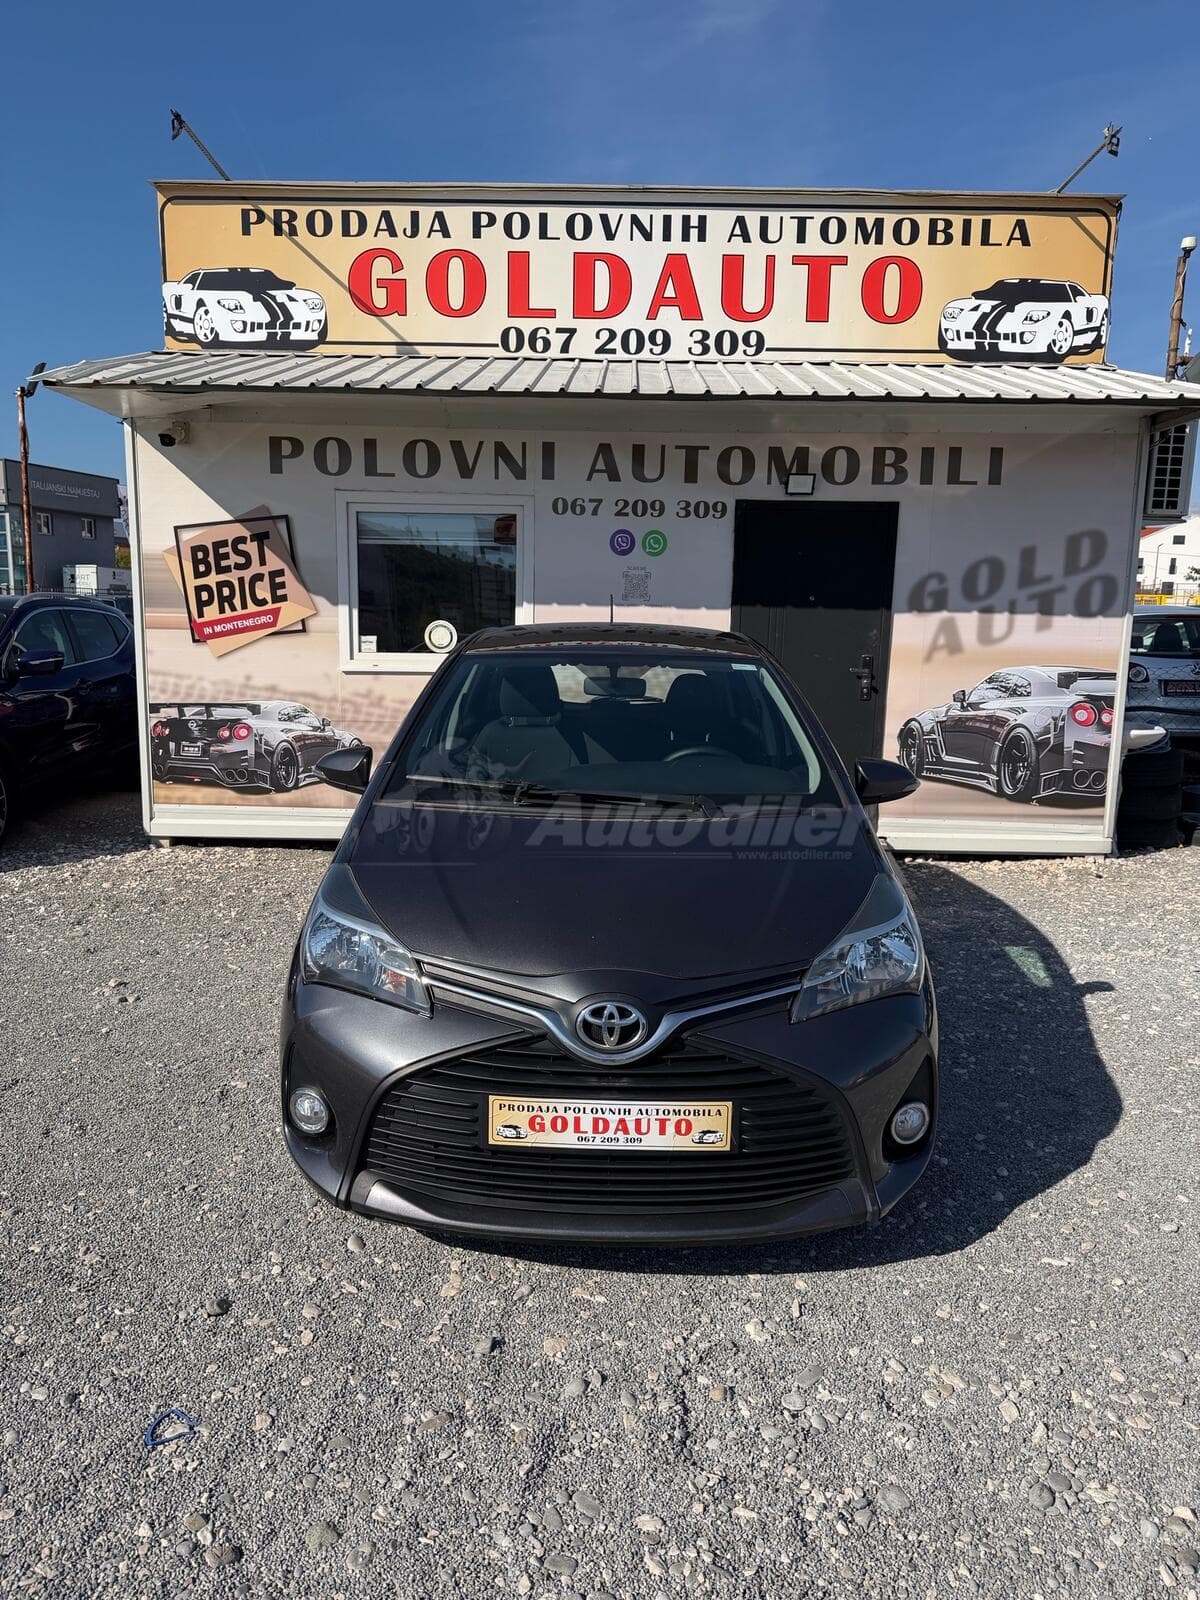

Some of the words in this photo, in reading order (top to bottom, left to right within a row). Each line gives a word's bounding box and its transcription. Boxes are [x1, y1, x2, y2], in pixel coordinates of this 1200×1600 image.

[240, 207, 452, 239] PRODAJA
[471, 210, 708, 243] POLOVNIH
[726, 214, 1032, 247] AUTOMOBILA
[347, 247, 923, 325] GOLDAUTO
[499, 326, 577, 355] 067
[594, 327, 672, 356] 209
[688, 328, 767, 357] 309
[267, 435, 556, 481] POLOVNI
[585, 442, 1005, 486] AUTOMOBILI
[551, 496, 603, 517] 067
[614, 498, 666, 518] 209
[676, 499, 728, 519] 309
[190, 531, 270, 580] BEST
[907, 528, 1108, 612] GOLD
[194, 568, 289, 619] PRICE
[203, 626, 213, 635] IN
[214, 614, 274, 632] MONTENEGRO
[922, 573, 1118, 663] AUTO
[498, 1103, 559, 1114] PRODAJA
[564, 1106, 632, 1116] POLOVNIH
[636, 1108, 723, 1117] AUTOMOBILA
[528, 1114, 693, 1137] GOLDAUTO
[577, 1135, 597, 1143] 067
[600, 1136, 620, 1144] 209
